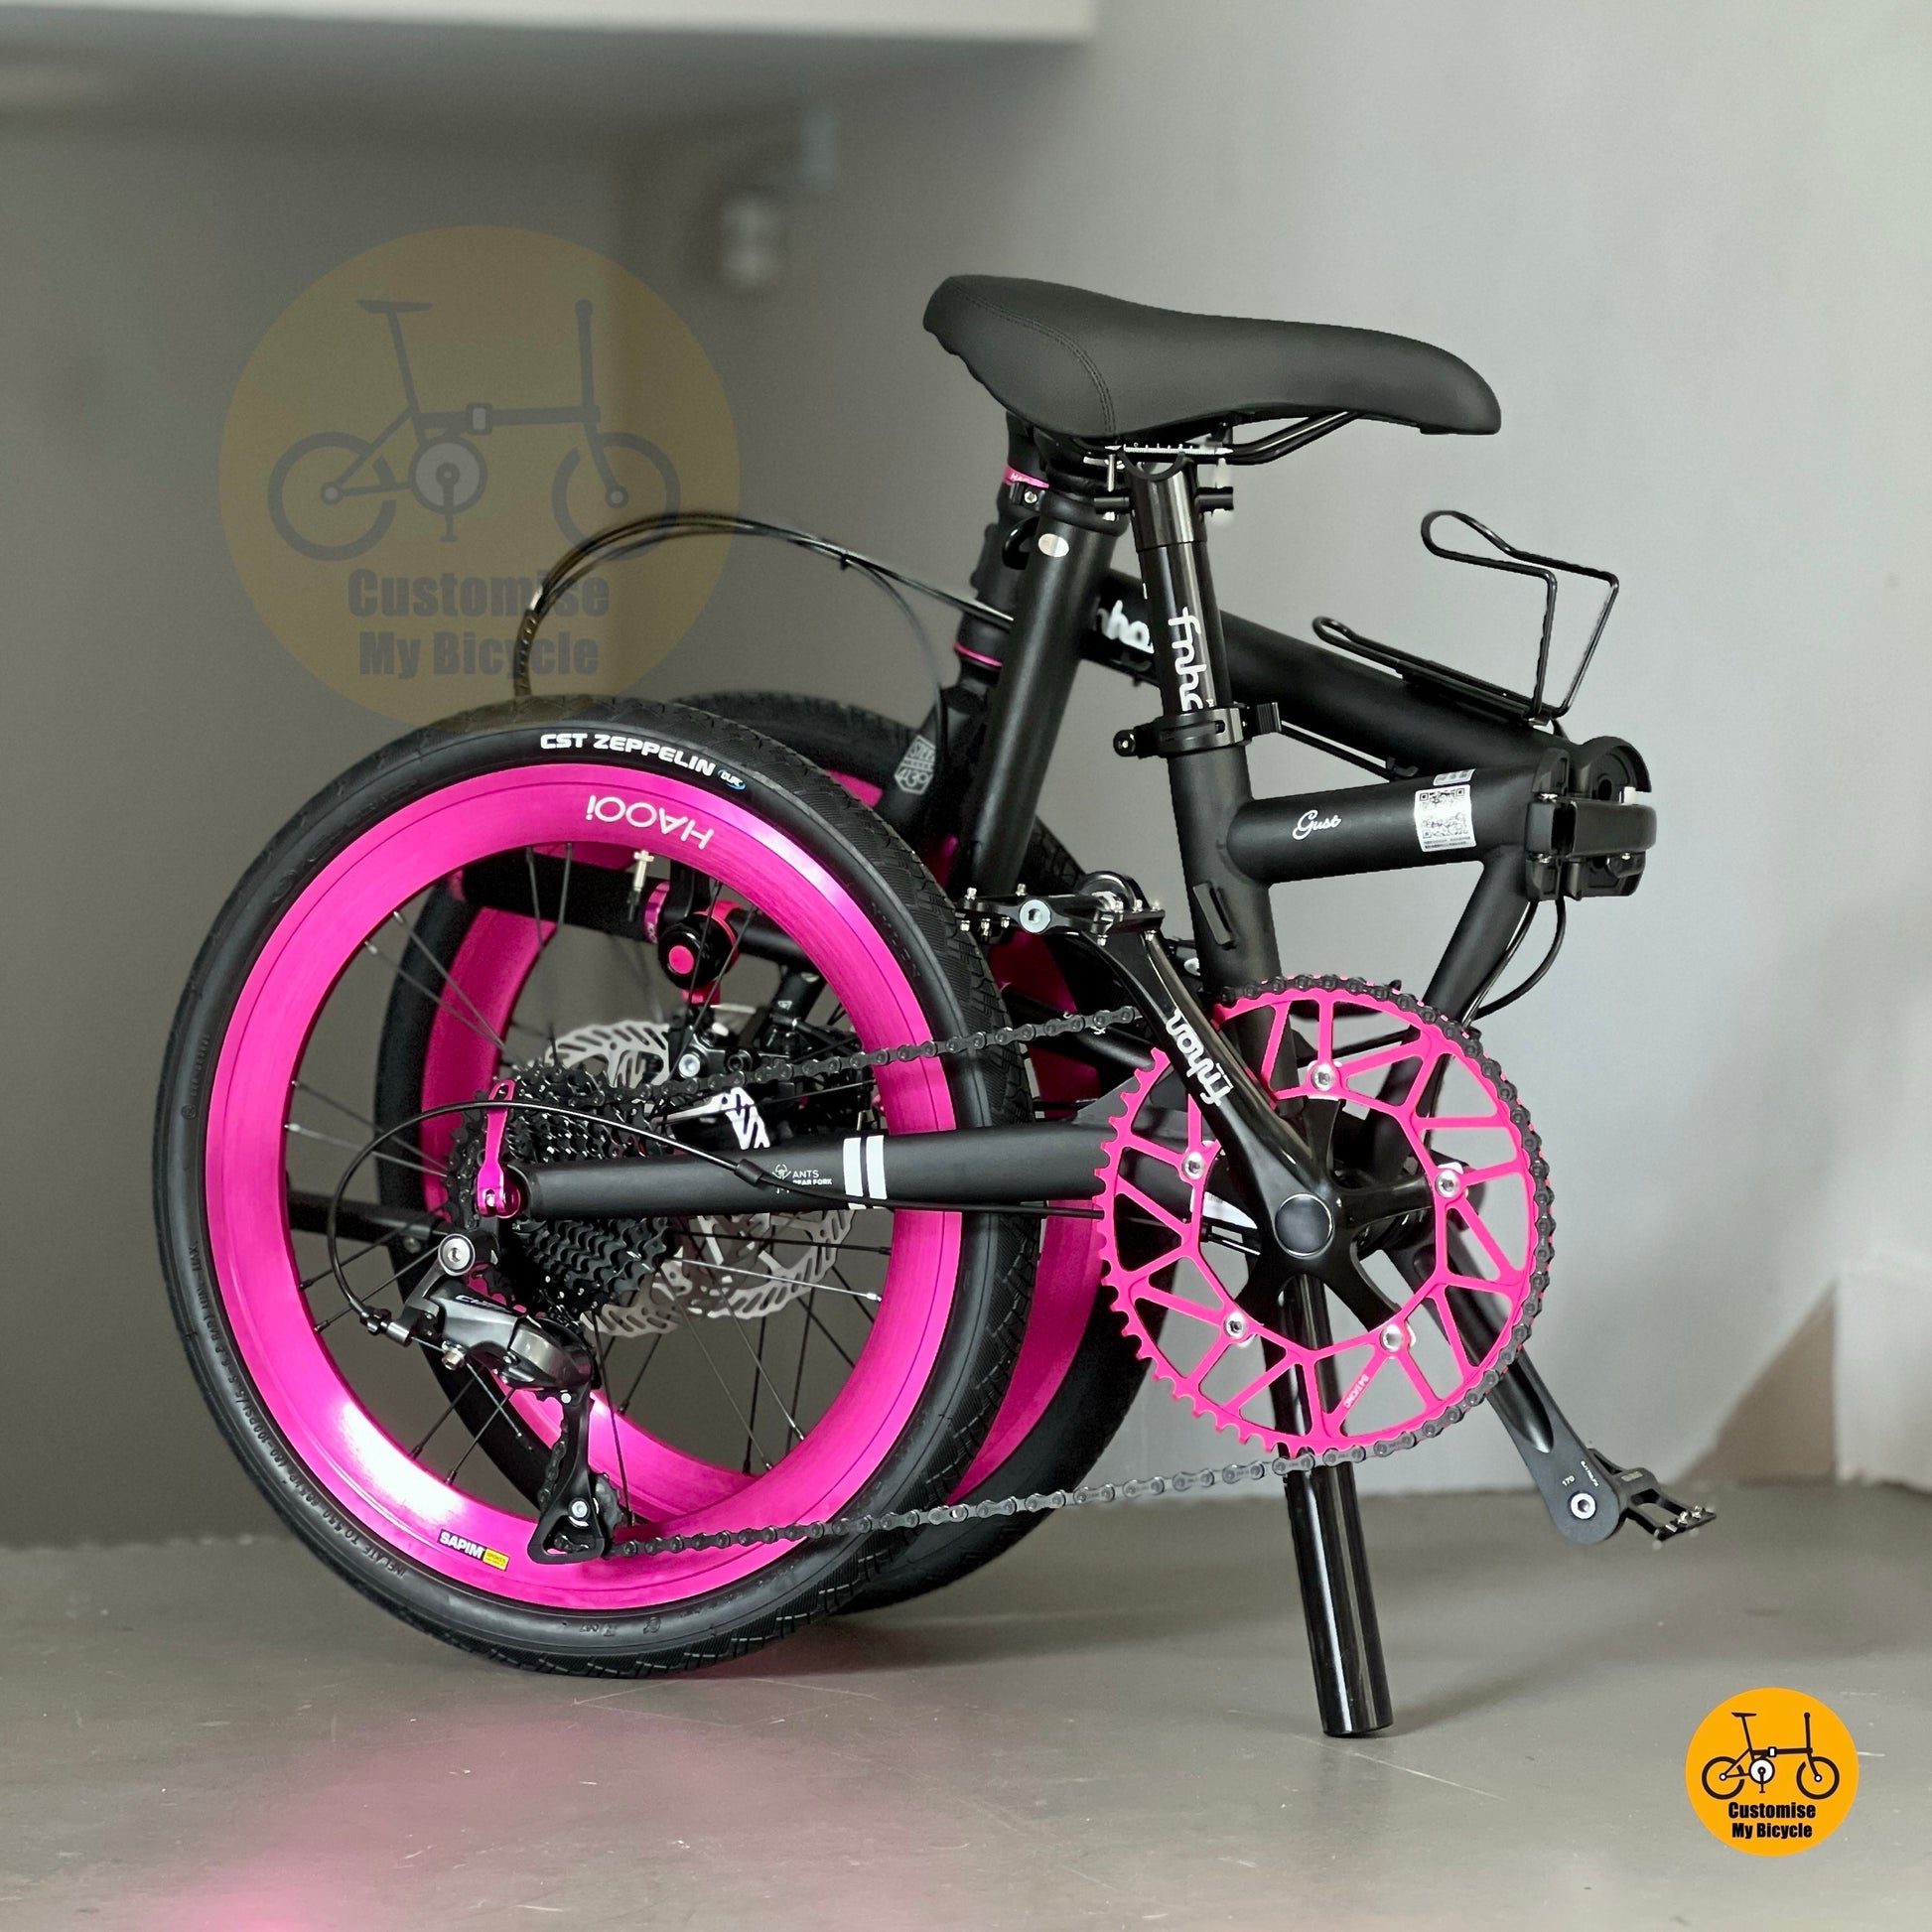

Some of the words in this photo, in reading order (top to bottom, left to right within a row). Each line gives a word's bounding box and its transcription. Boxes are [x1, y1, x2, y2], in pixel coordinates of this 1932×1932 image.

[540, 733, 588, 749] CST
[593, 734, 716, 776] ZEPPELIN
[1292, 809, 1342, 841] Gust
[1166, 1007, 1233, 1107] fnhon
[792, 1170, 820, 1178] ANTS
[1562, 1474, 1577, 1487] 170
[439, 1530, 485, 1560] SAPIM
